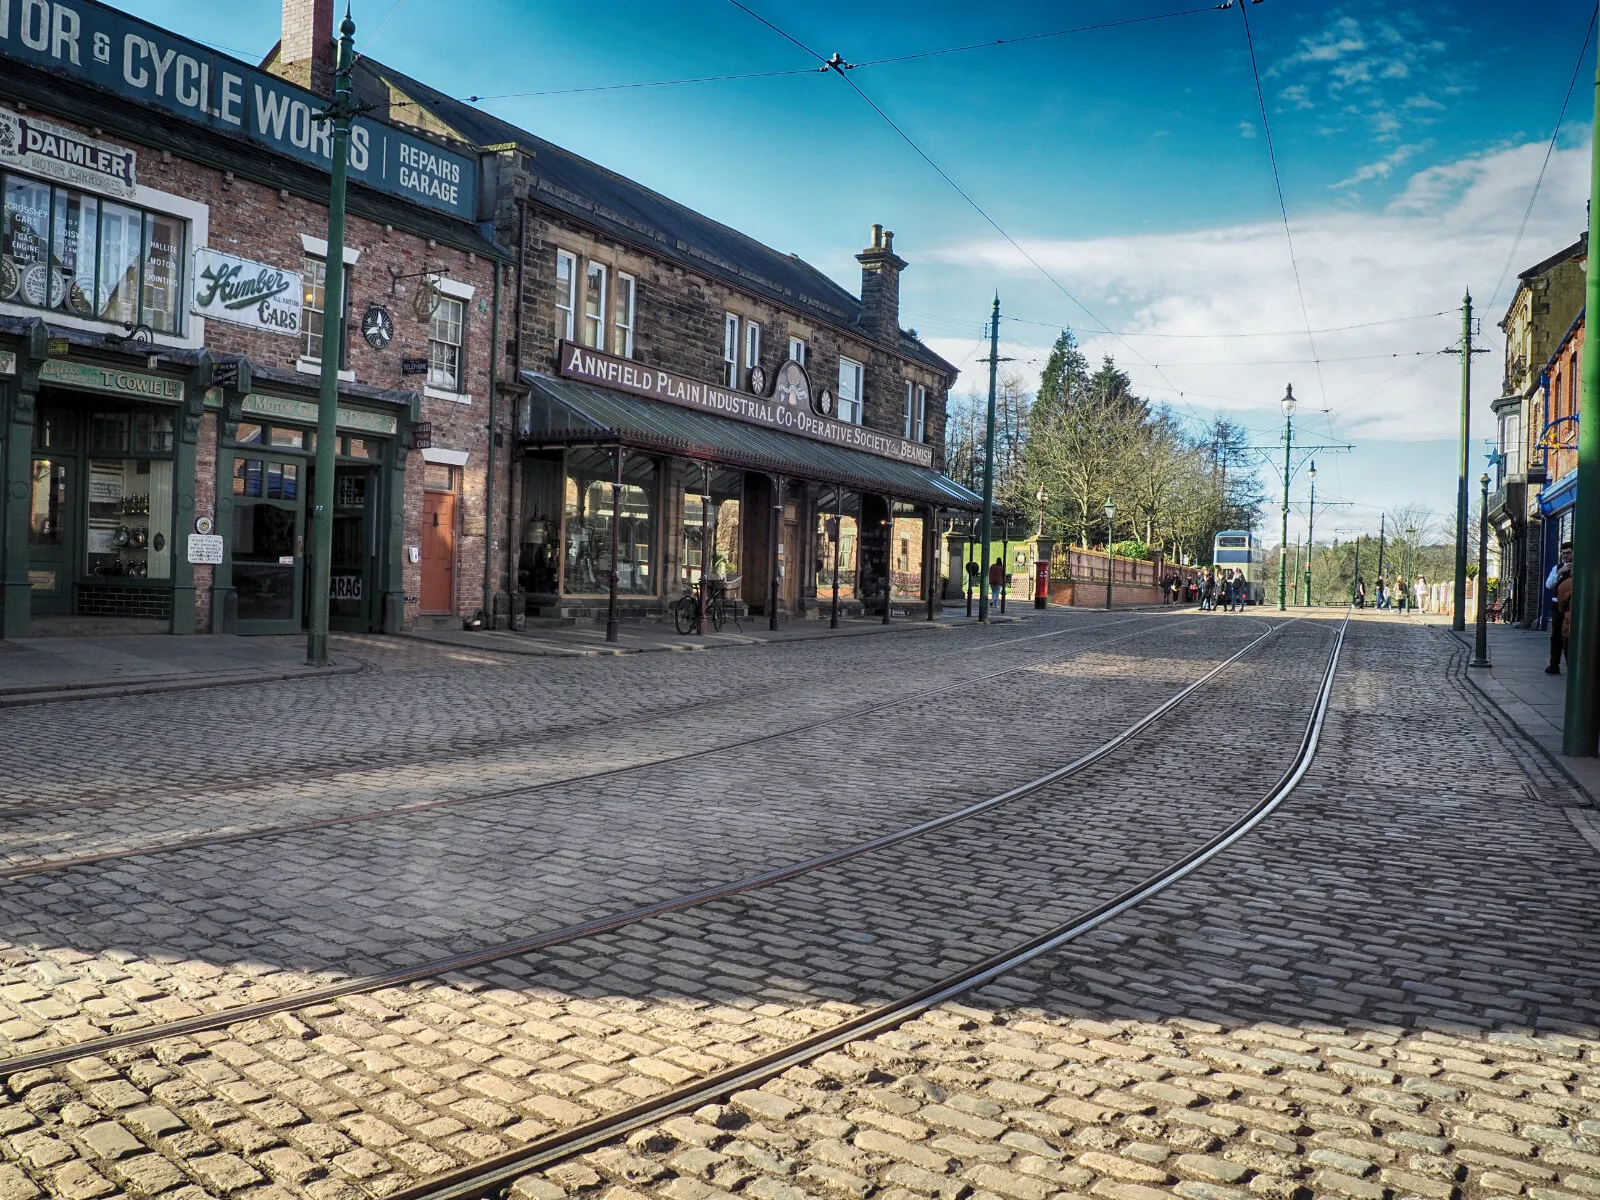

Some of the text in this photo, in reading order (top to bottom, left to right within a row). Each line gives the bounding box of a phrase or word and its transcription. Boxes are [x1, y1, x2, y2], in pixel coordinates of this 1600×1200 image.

[93, 32, 110, 64] &
[124, 34, 242, 125] CYCLE
[26, 129, 125, 177] DAIMLER
[31, 155, 66, 177] MOTOR
[400, 143, 460, 184] REPAIRS
[400, 167, 458, 205] GARAGE
[7, 201, 48, 219] CROSSLEY
[15, 213, 38, 226] CARS
[12, 240, 39, 254] ENGINE
[17, 233, 33, 243] GAS
[150, 240, 177, 254] HALLITE
[150, 257, 176, 270] MOTOR
[146, 273, 178, 287] JOINTING
[196, 263, 290, 310] Humber
[257, 300, 297, 330] CARS
[403, 362, 427, 371] TELEPHONE
[116, 374, 162, 395] COWIE
[567, 348, 652, 390] ANNFIELD
[656, 371, 700, 403] PLAIN
[702, 385, 774, 422] INDUSTRIAL
[776, 405, 852, 443] CO-OPERATIVE
[853, 428, 891, 452] SOCIETY
[900, 441, 932, 464] BEAMISH
[329, 577, 361, 597] ARAG
